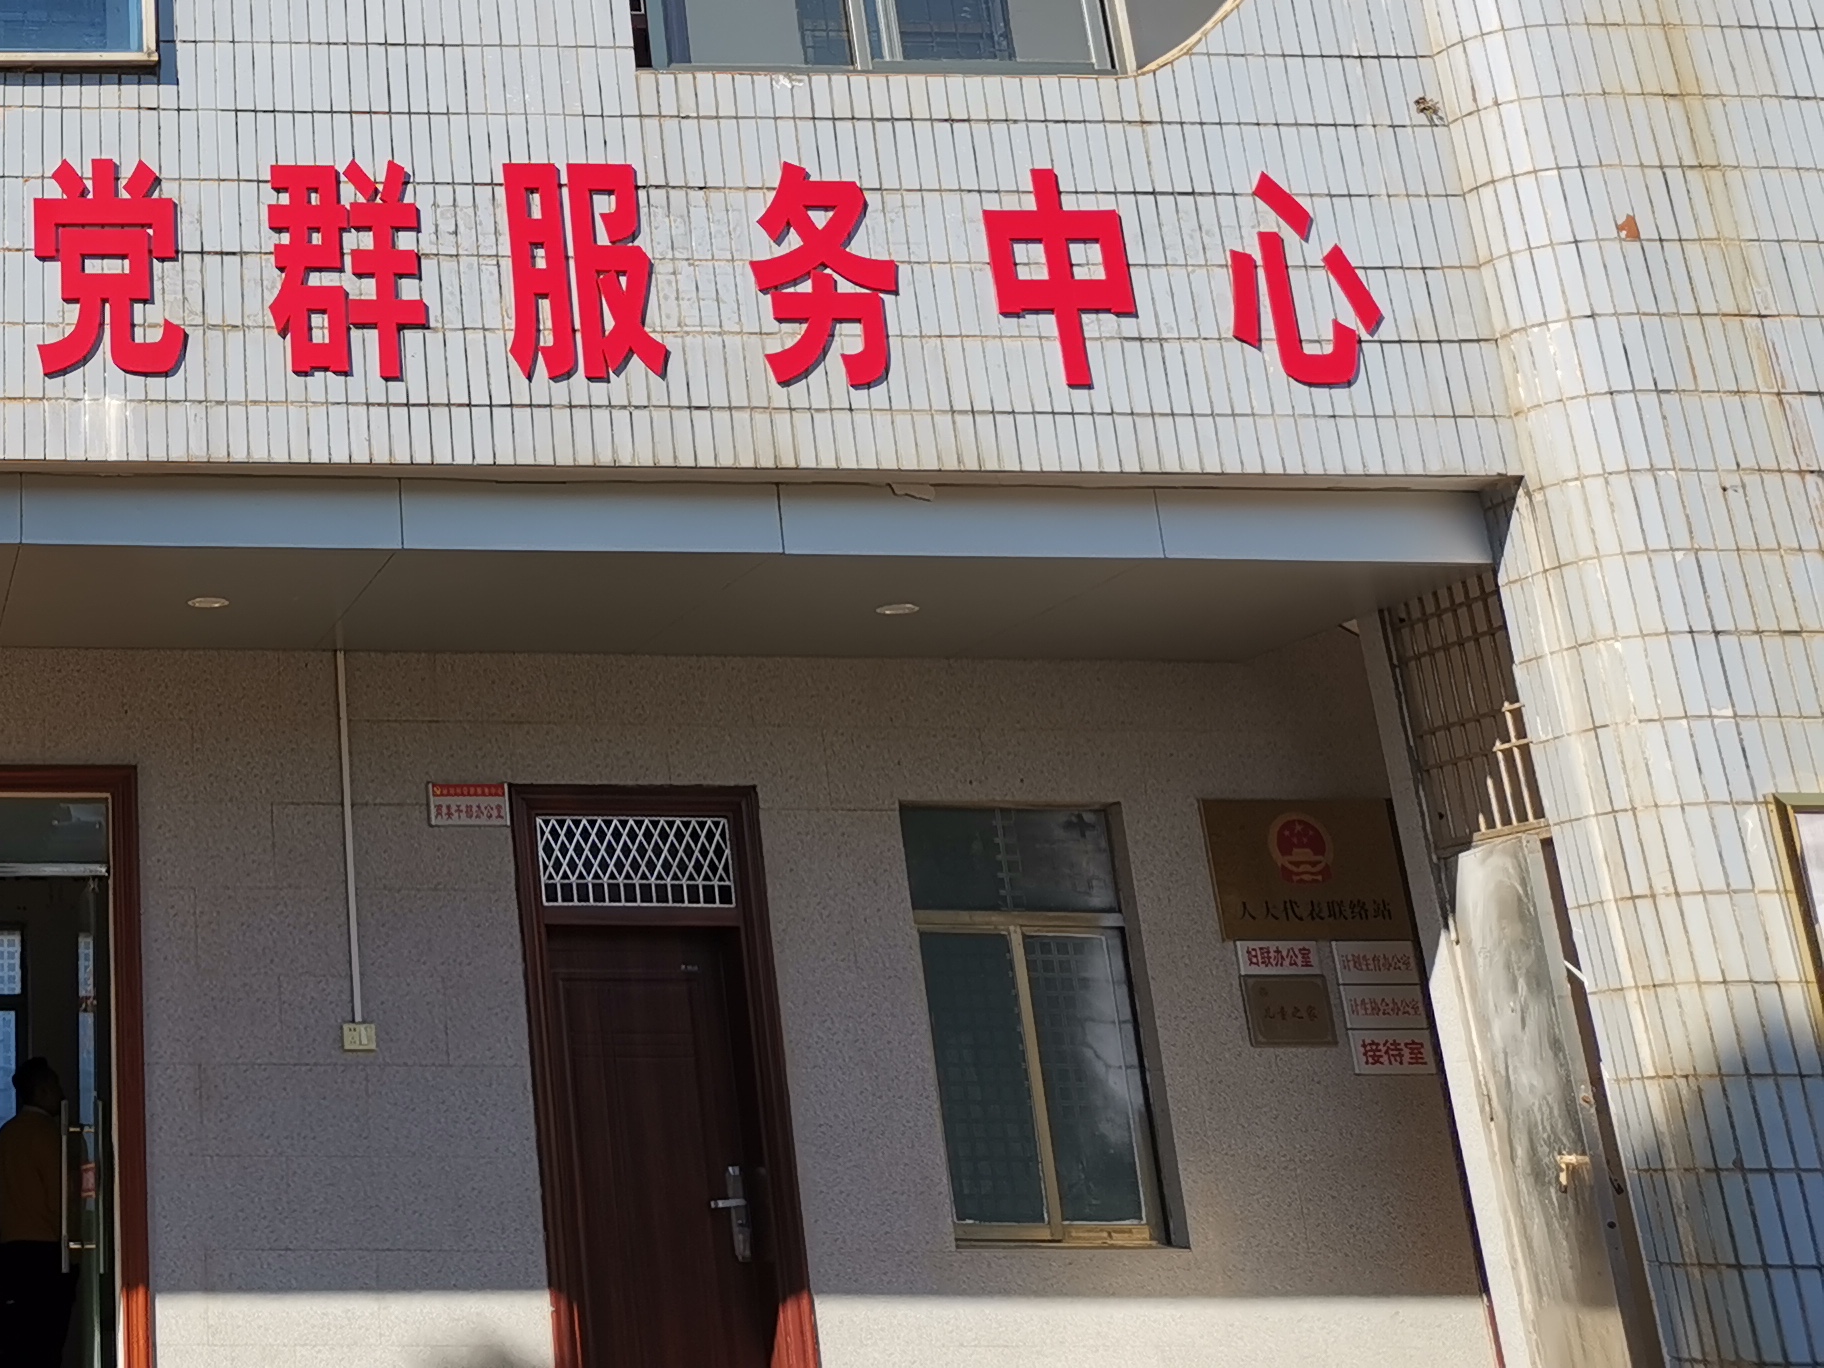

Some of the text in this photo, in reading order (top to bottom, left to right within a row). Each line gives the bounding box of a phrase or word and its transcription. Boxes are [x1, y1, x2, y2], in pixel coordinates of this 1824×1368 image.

[1239, 898, 1393, 922] 人大代表联络站
[1246, 945, 1314, 968] 妇联办公室
[1340, 953, 1413, 972] 计划生育办公室
[1349, 996, 1422, 1017] 计生协会办公室
[1360, 1038, 1429, 1066] 接待室
